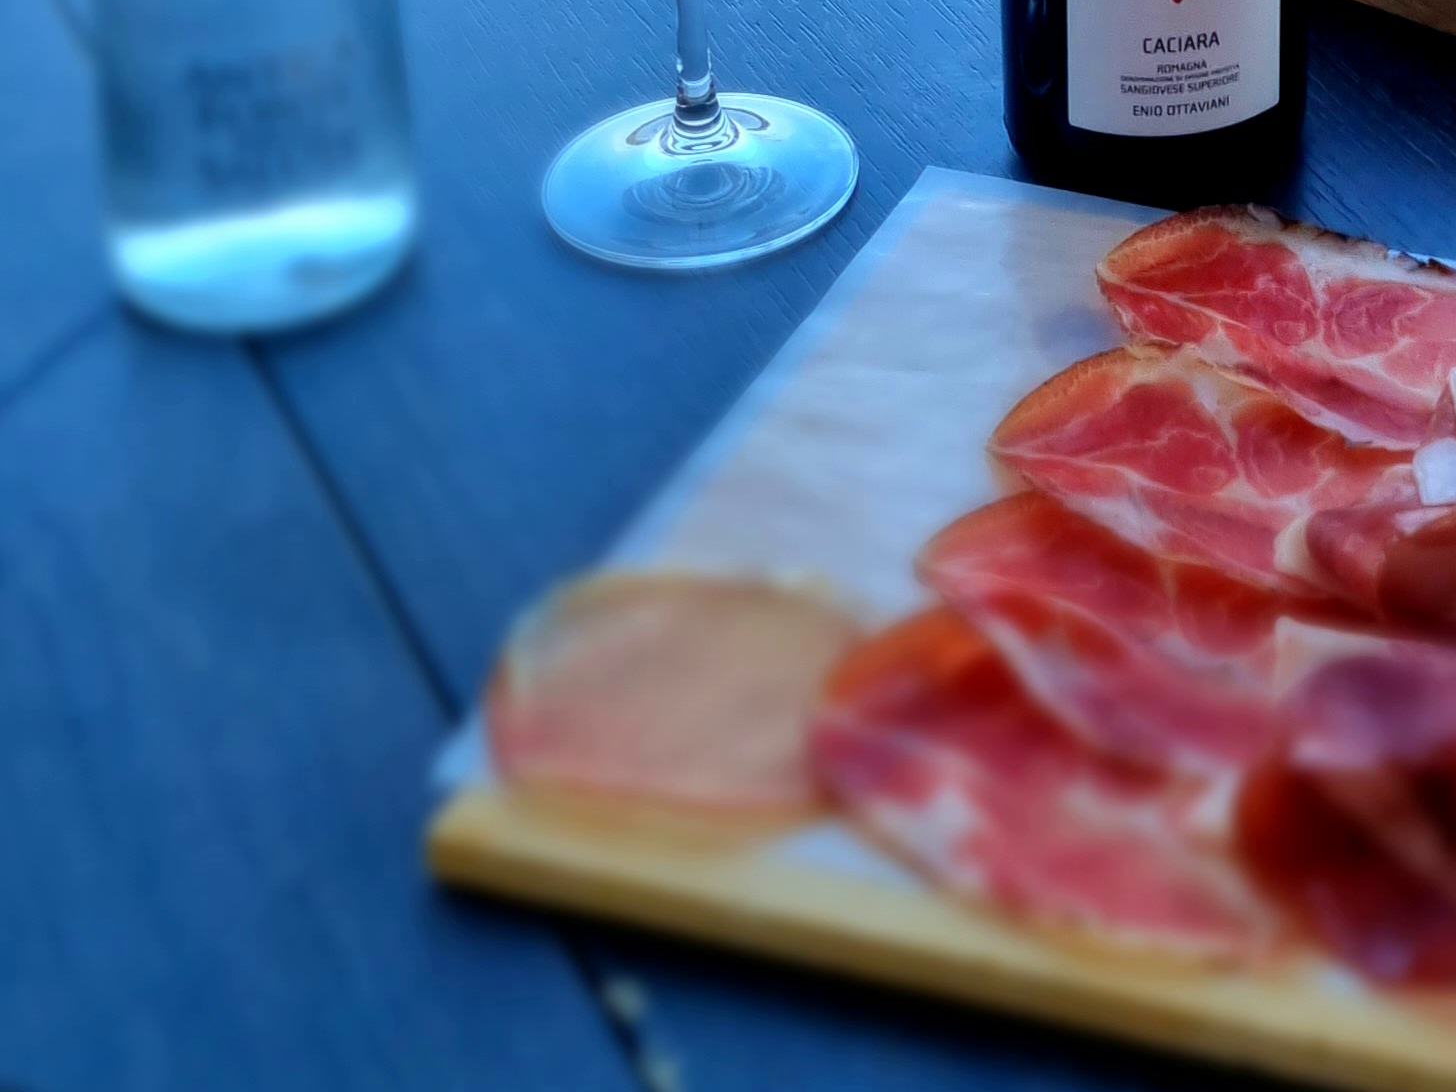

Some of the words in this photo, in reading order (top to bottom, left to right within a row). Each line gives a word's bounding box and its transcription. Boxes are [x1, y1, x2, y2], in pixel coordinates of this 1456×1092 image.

[1143, 31, 1220, 54] CACIARA
[1156, 60, 1208, 74] ROMAGNA
[1120, 82, 1185, 95] SANGIOVESE
[1187, 72, 1240, 92] SUPERIORE
[1132, 104, 1163, 117] ENIO
[1166, 95, 1230, 116] OTTAVIANI
